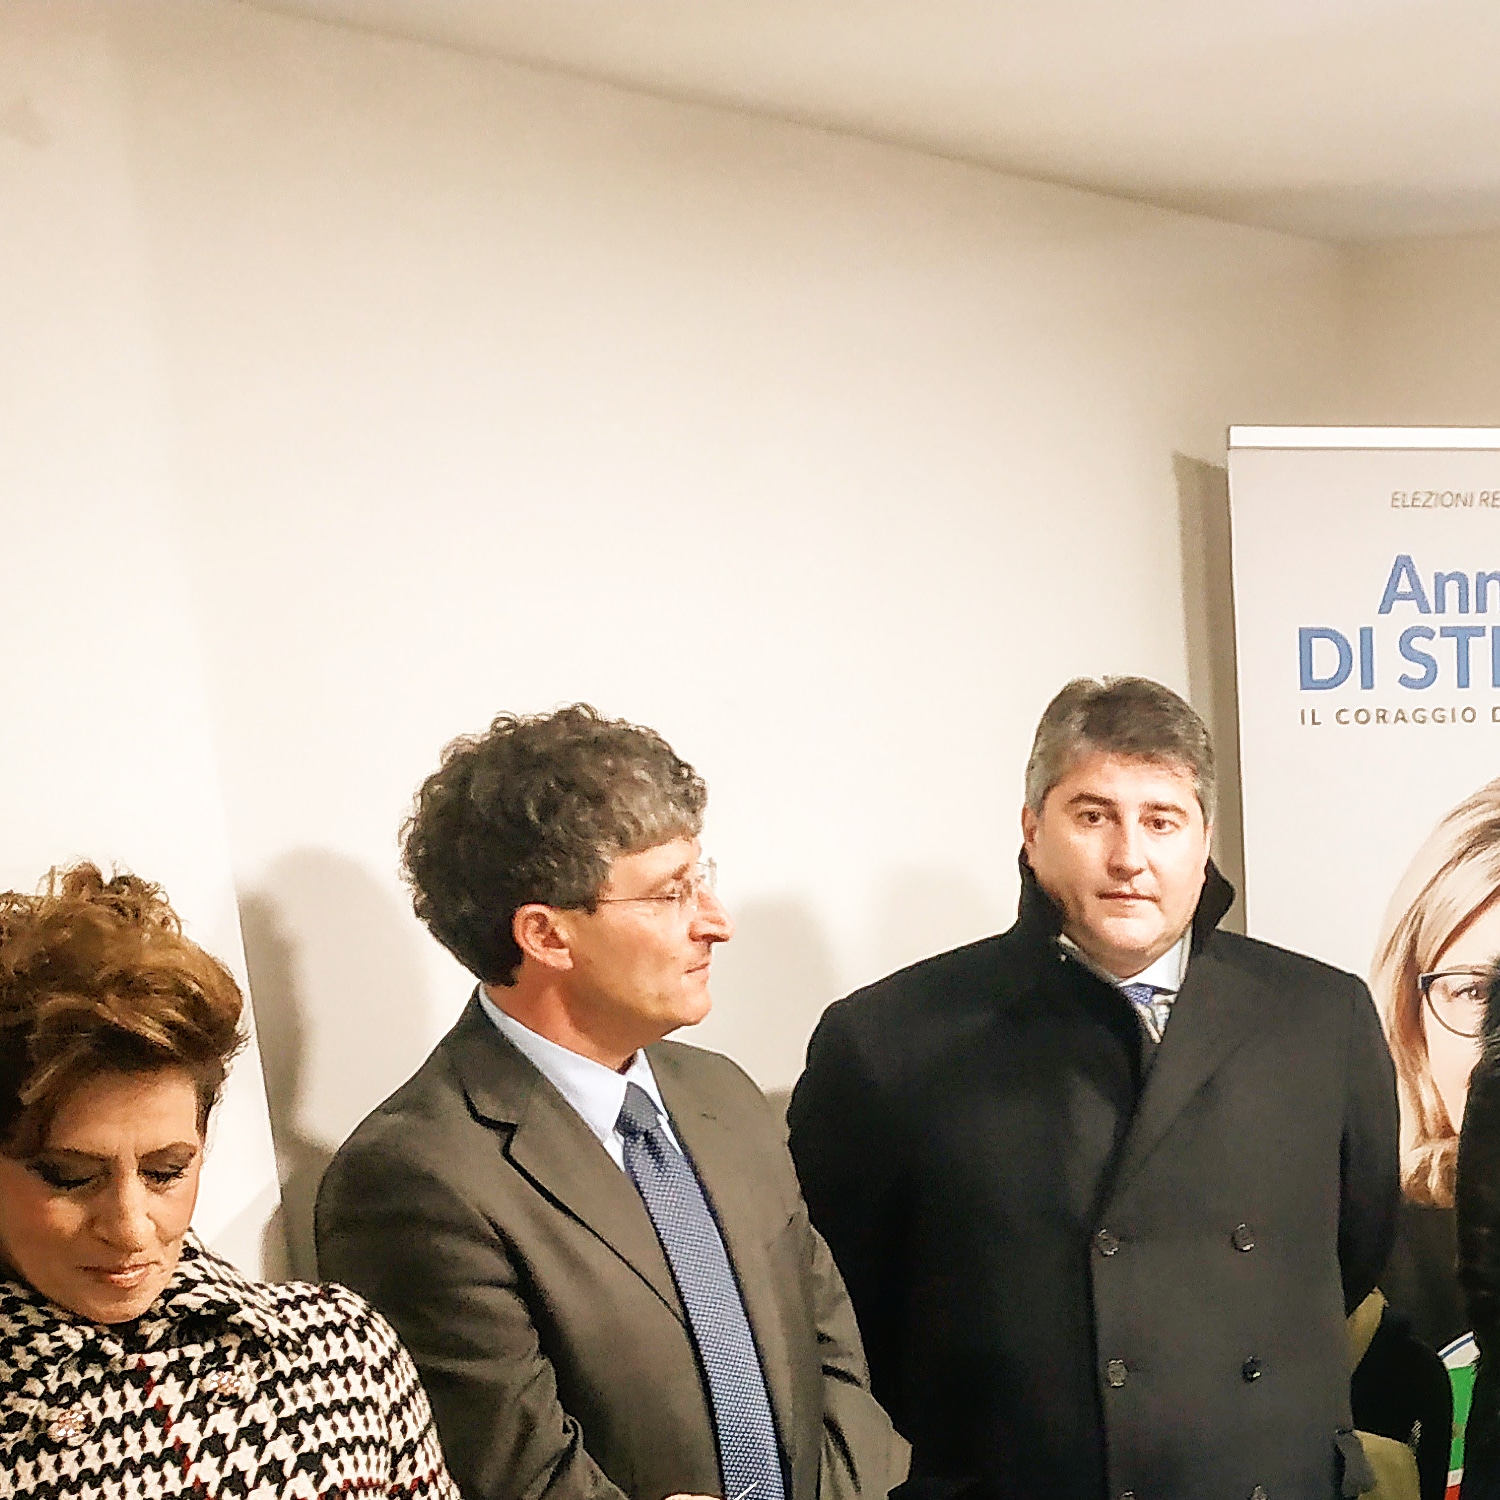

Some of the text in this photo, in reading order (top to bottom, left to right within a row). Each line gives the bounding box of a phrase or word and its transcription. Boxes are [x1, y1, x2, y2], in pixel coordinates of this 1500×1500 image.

[1390, 490, 1474, 509] ELEZIONI
[1298, 626, 1375, 692] DI
[1299, 708, 1322, 726] IL
[1335, 706, 1478, 726] CORAGGIO
